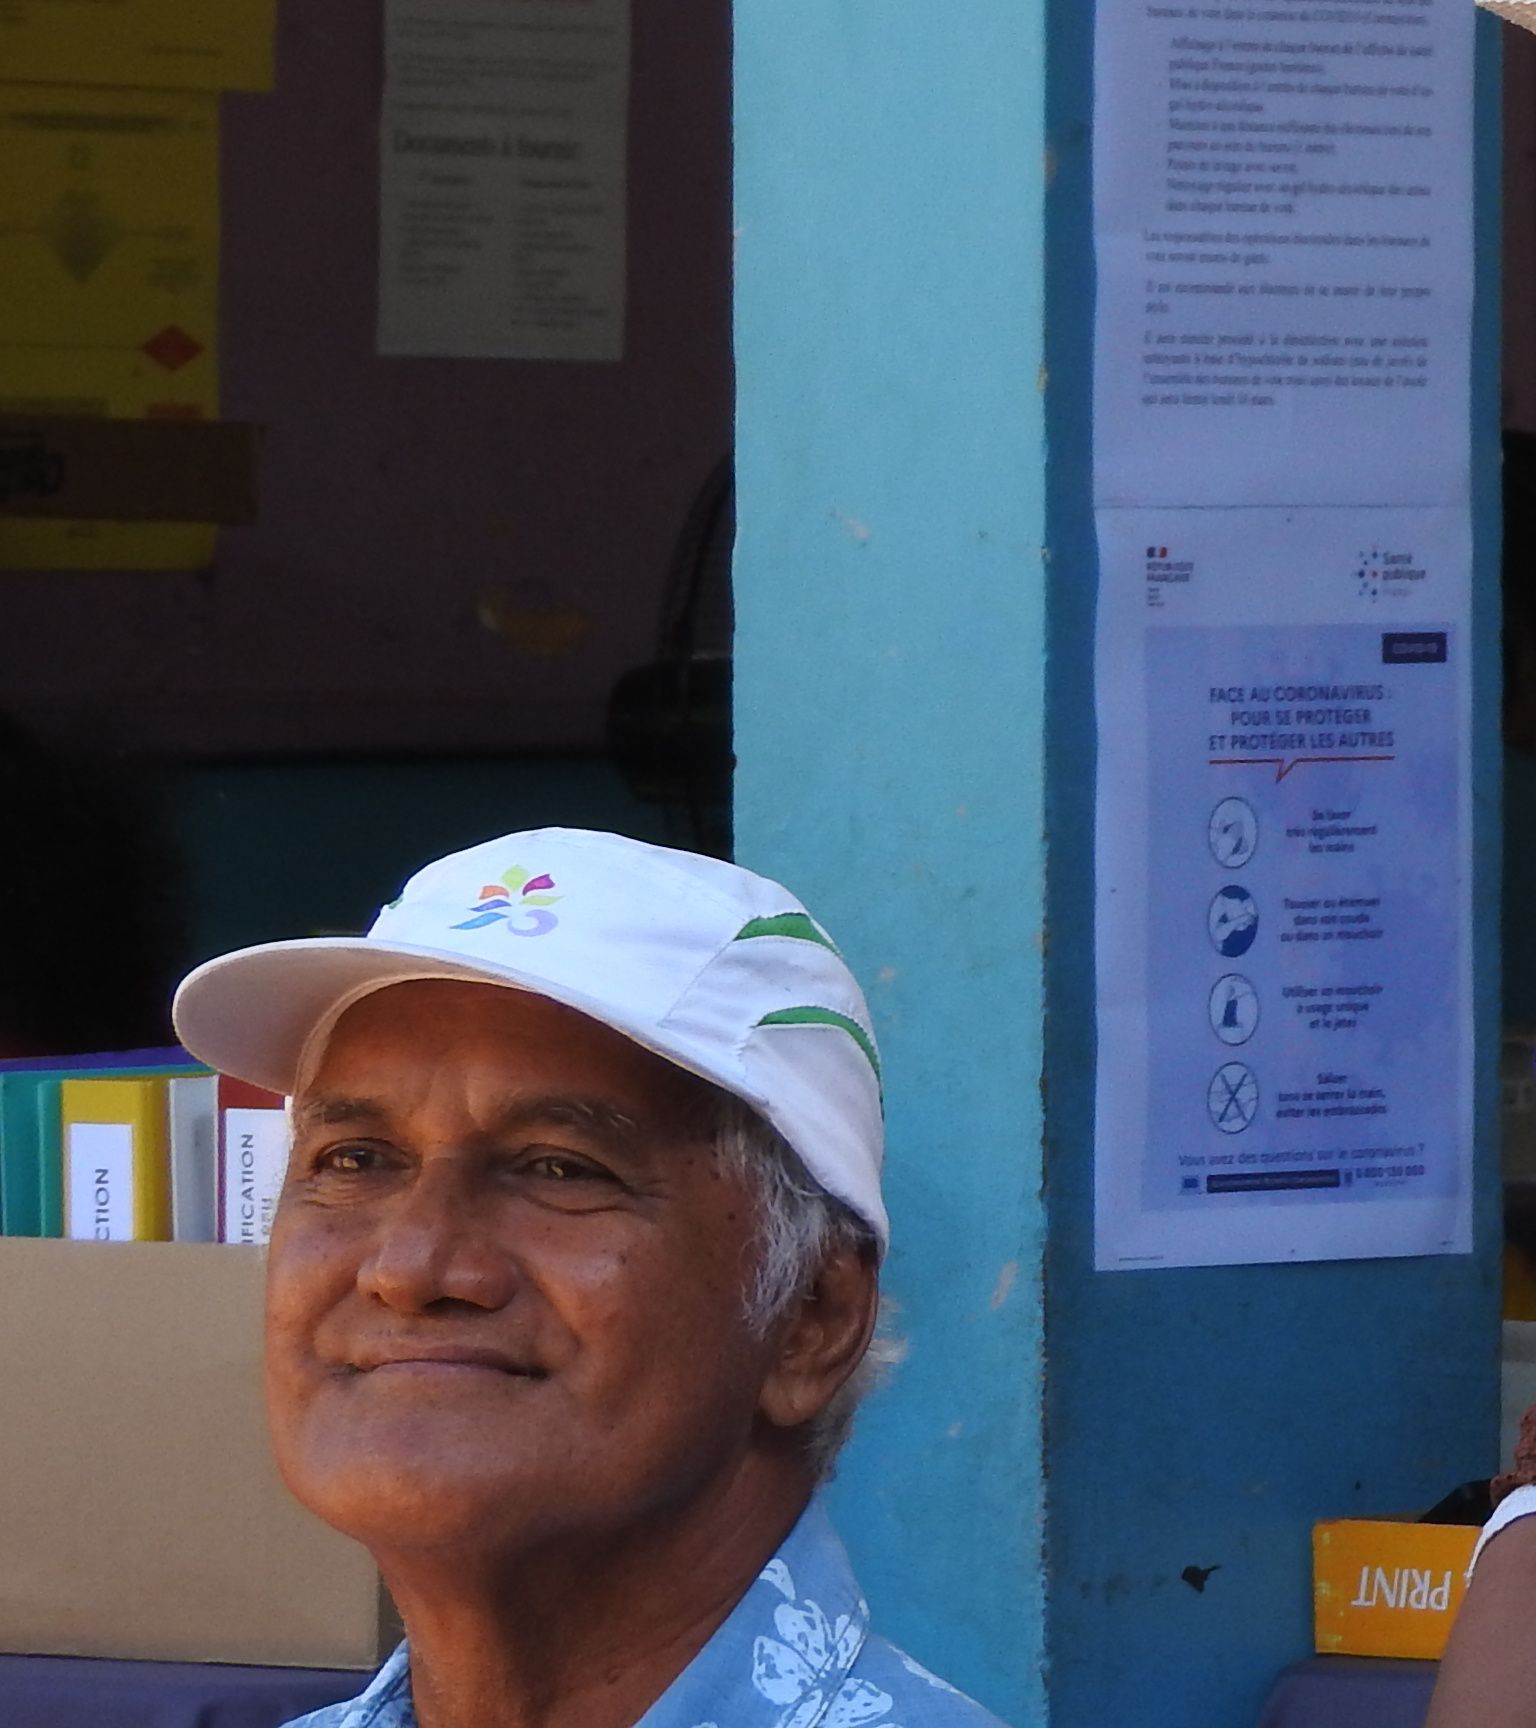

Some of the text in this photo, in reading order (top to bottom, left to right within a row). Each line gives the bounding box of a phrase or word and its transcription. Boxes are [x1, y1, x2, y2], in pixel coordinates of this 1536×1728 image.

[1209, 685, 1245, 704] FACE
[1250, 686, 1271, 703] AU
[1273, 684, 1384, 703] CORONAVIRUS
[1230, 708, 1271, 726] POUR
[1275, 708, 1294, 726] SE
[1209, 734, 1226, 752] ET
[1310, 733, 1335, 749] LES
[1338, 730, 1395, 748] AUTRES
[1350, 1565, 1453, 1612] PRINT
